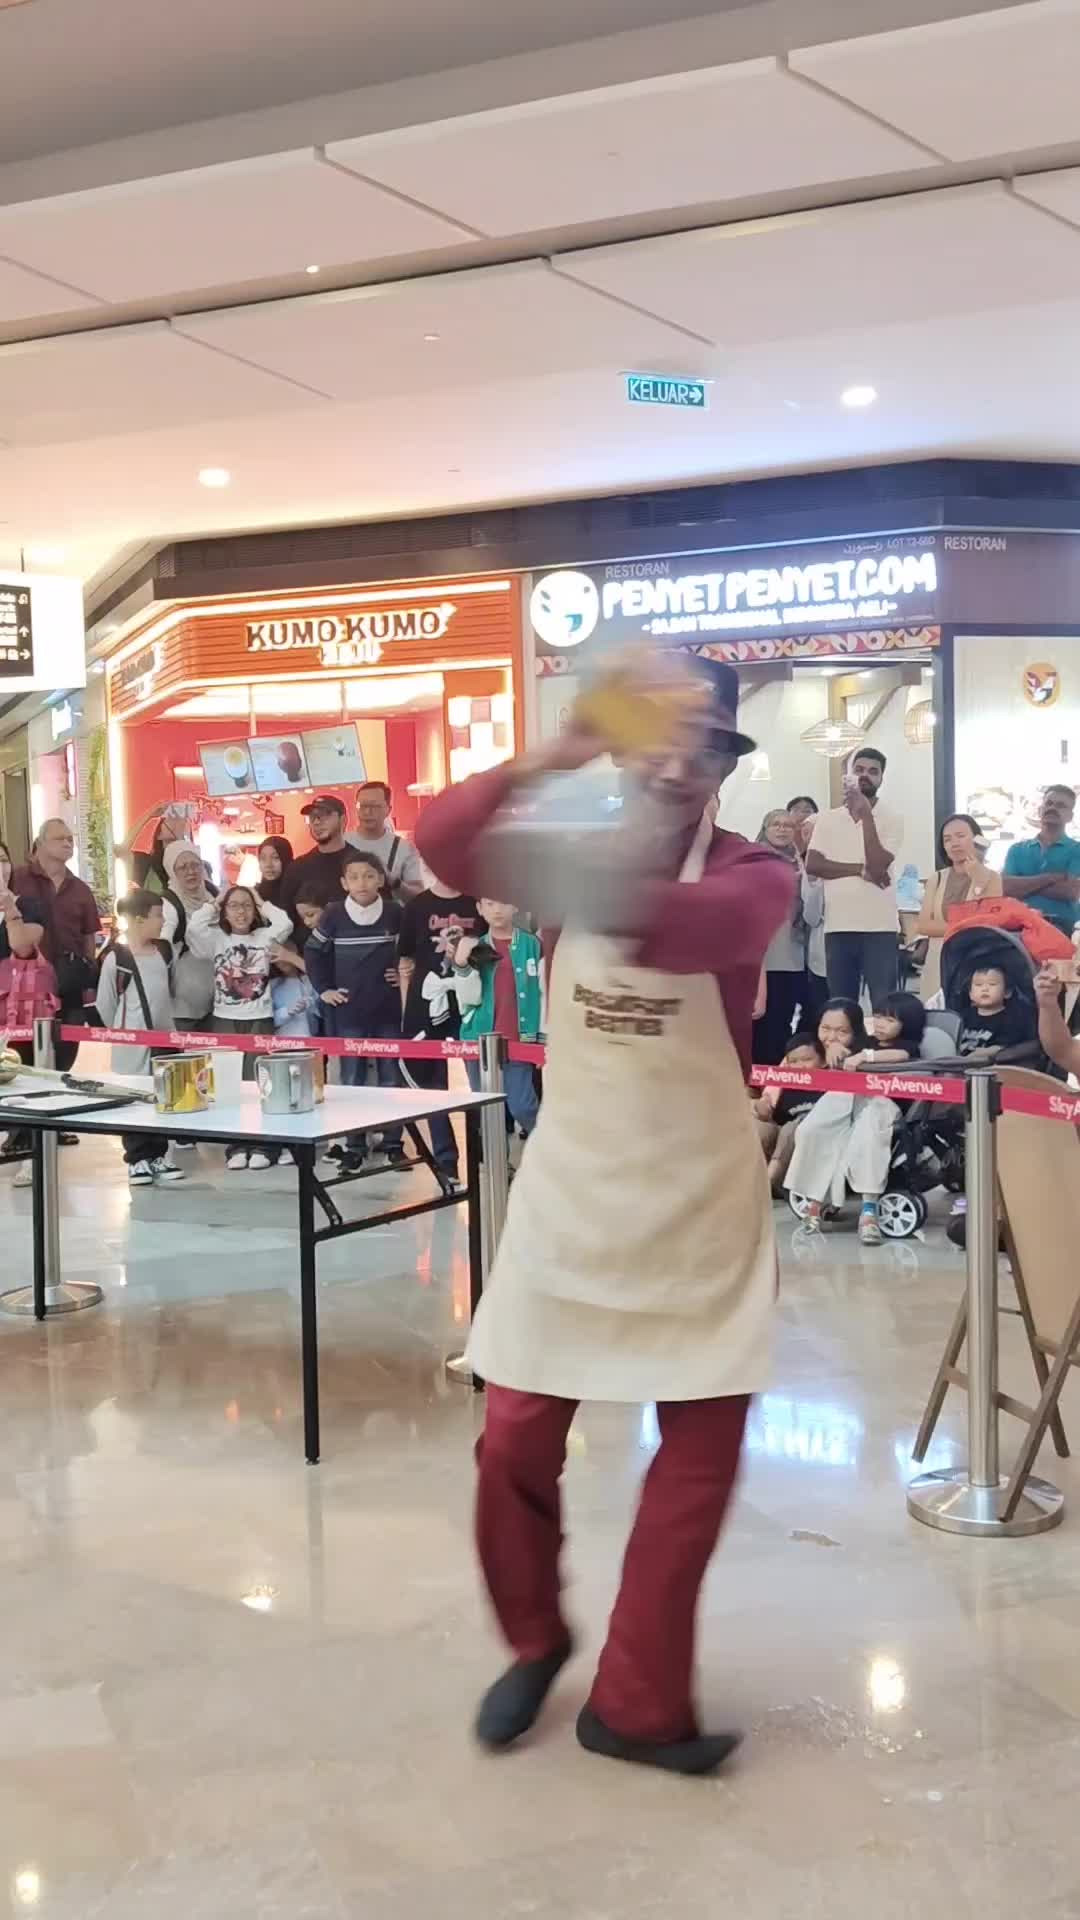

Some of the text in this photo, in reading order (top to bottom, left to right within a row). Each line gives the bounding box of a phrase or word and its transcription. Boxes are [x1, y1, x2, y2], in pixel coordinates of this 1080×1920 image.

[629, 379, 689, 404] KELUAR
[944, 536, 1006, 550] RESTORAN
[605, 562, 670, 579] RESTORAN
[246, 609, 441, 649] KUMO KUMO
[90, 1027, 136, 1042] SkyAvenue
[170, 1031, 218, 1047] SkyAvenue
[254, 1035, 305, 1051] SkyAvenue
[344, 1039, 400, 1055] SkyAvenue
[866, 1074, 943, 1095] SkyAvenue
